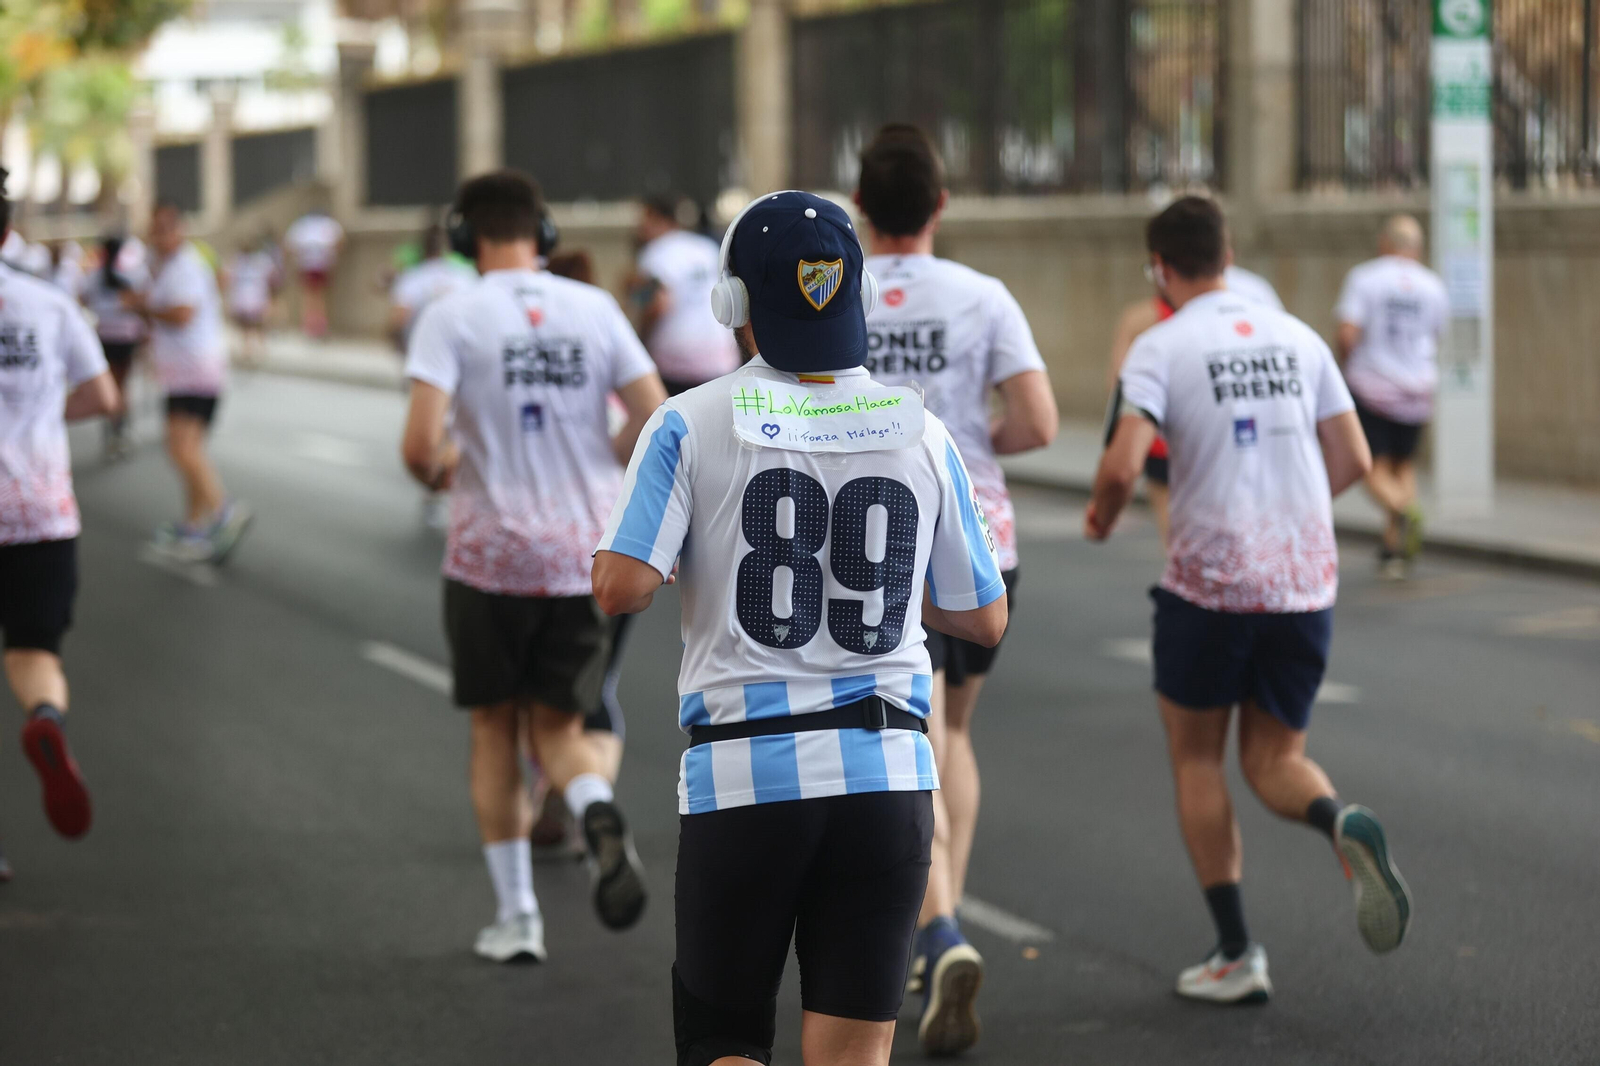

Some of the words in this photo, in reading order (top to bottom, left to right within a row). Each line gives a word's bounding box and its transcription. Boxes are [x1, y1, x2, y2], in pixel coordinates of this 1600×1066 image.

[867, 329, 946, 352] ONLE
[865, 353, 947, 375] RENO
[1208, 356, 1300, 380] PONLE
[1214, 378, 1302, 405] FRENO
[736, 467, 919, 655] 89
